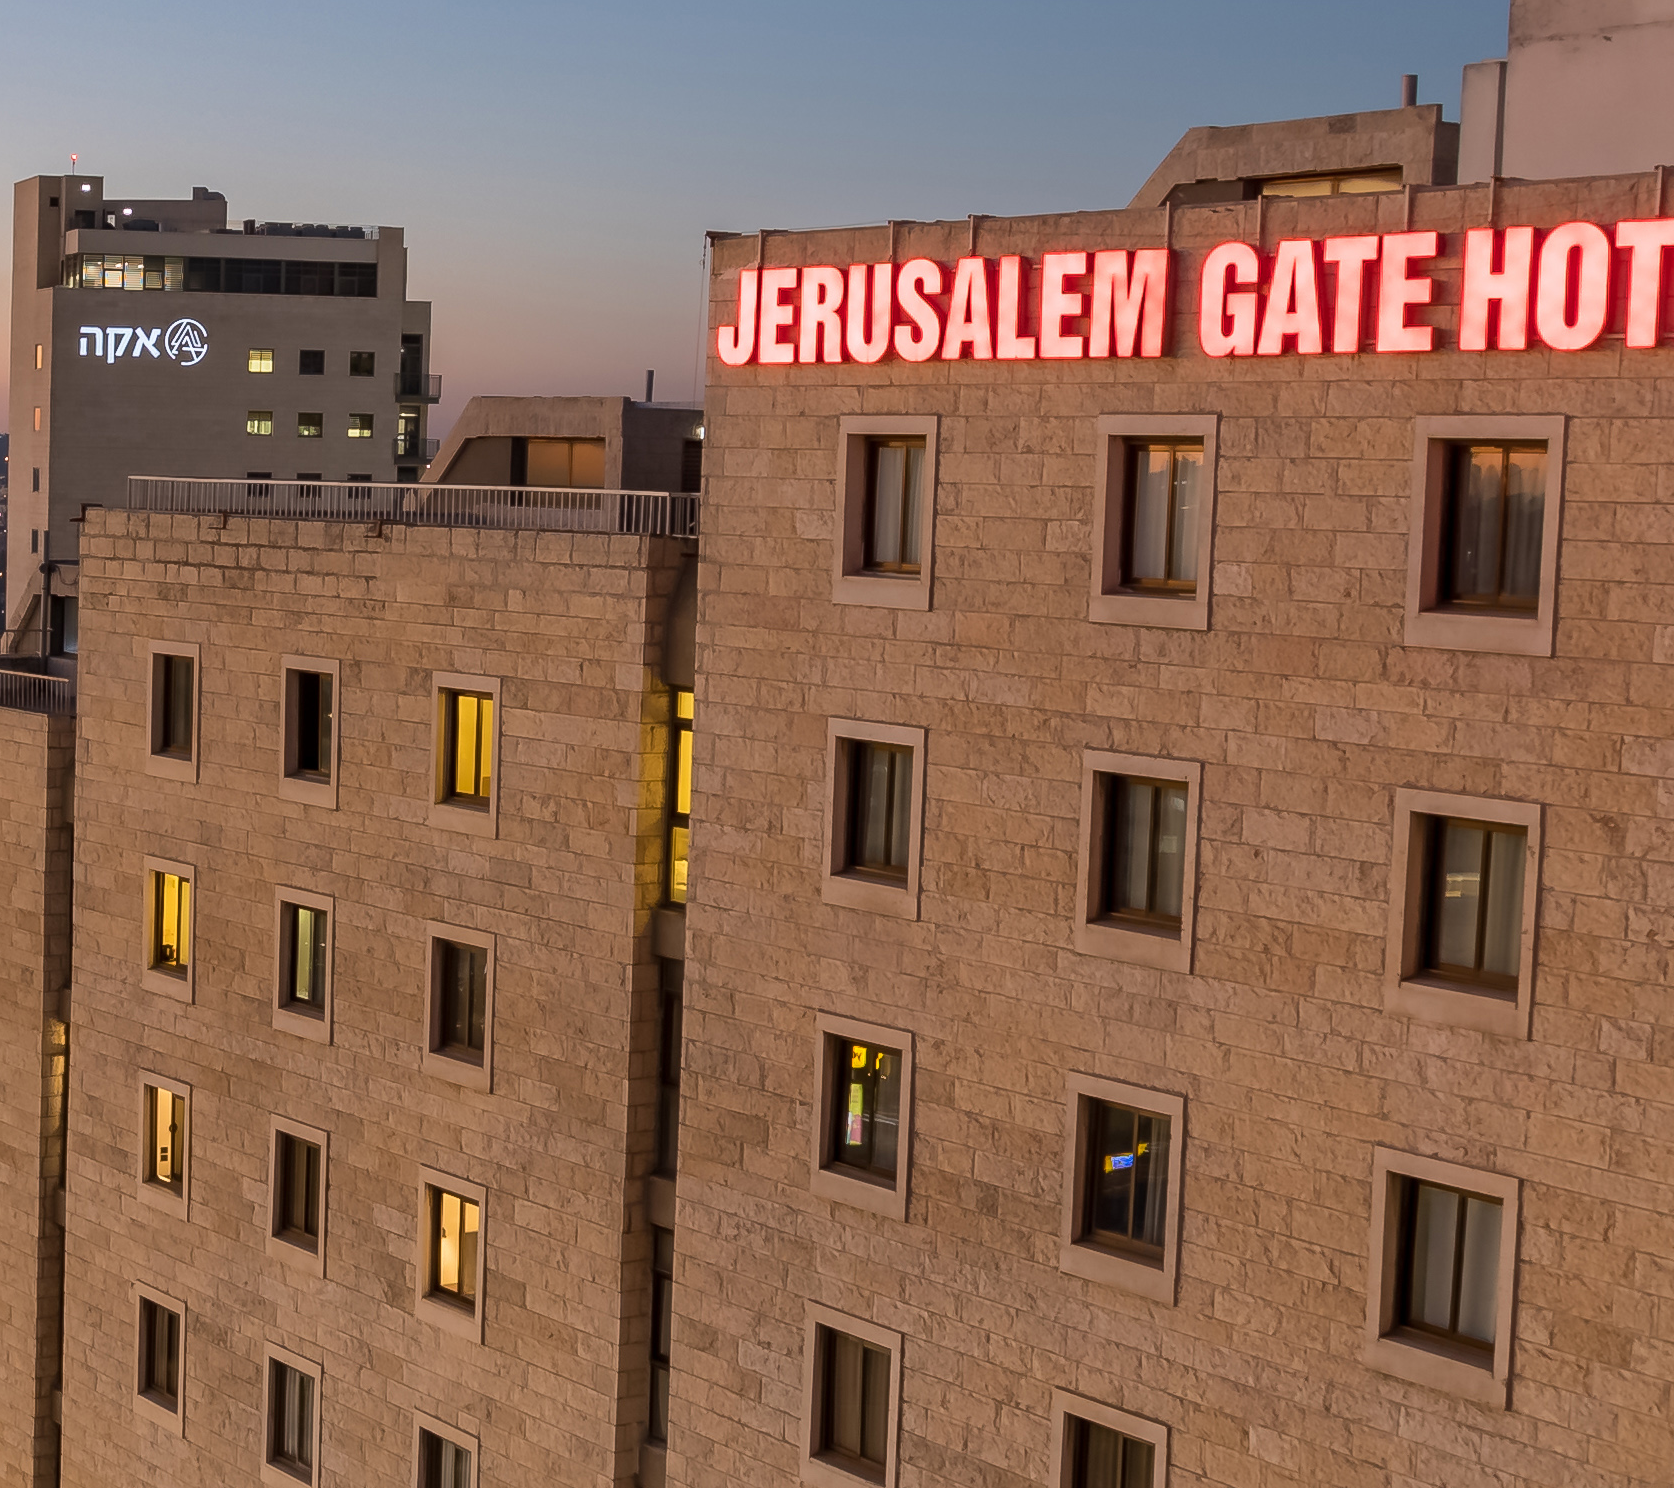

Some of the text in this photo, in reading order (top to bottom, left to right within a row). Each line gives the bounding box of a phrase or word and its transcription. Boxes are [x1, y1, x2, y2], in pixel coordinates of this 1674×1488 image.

[717, 248, 1170, 366] JERUSALEM
[1199, 230, 1438, 357] GATE
[79, 326, 162, 364] אקה
